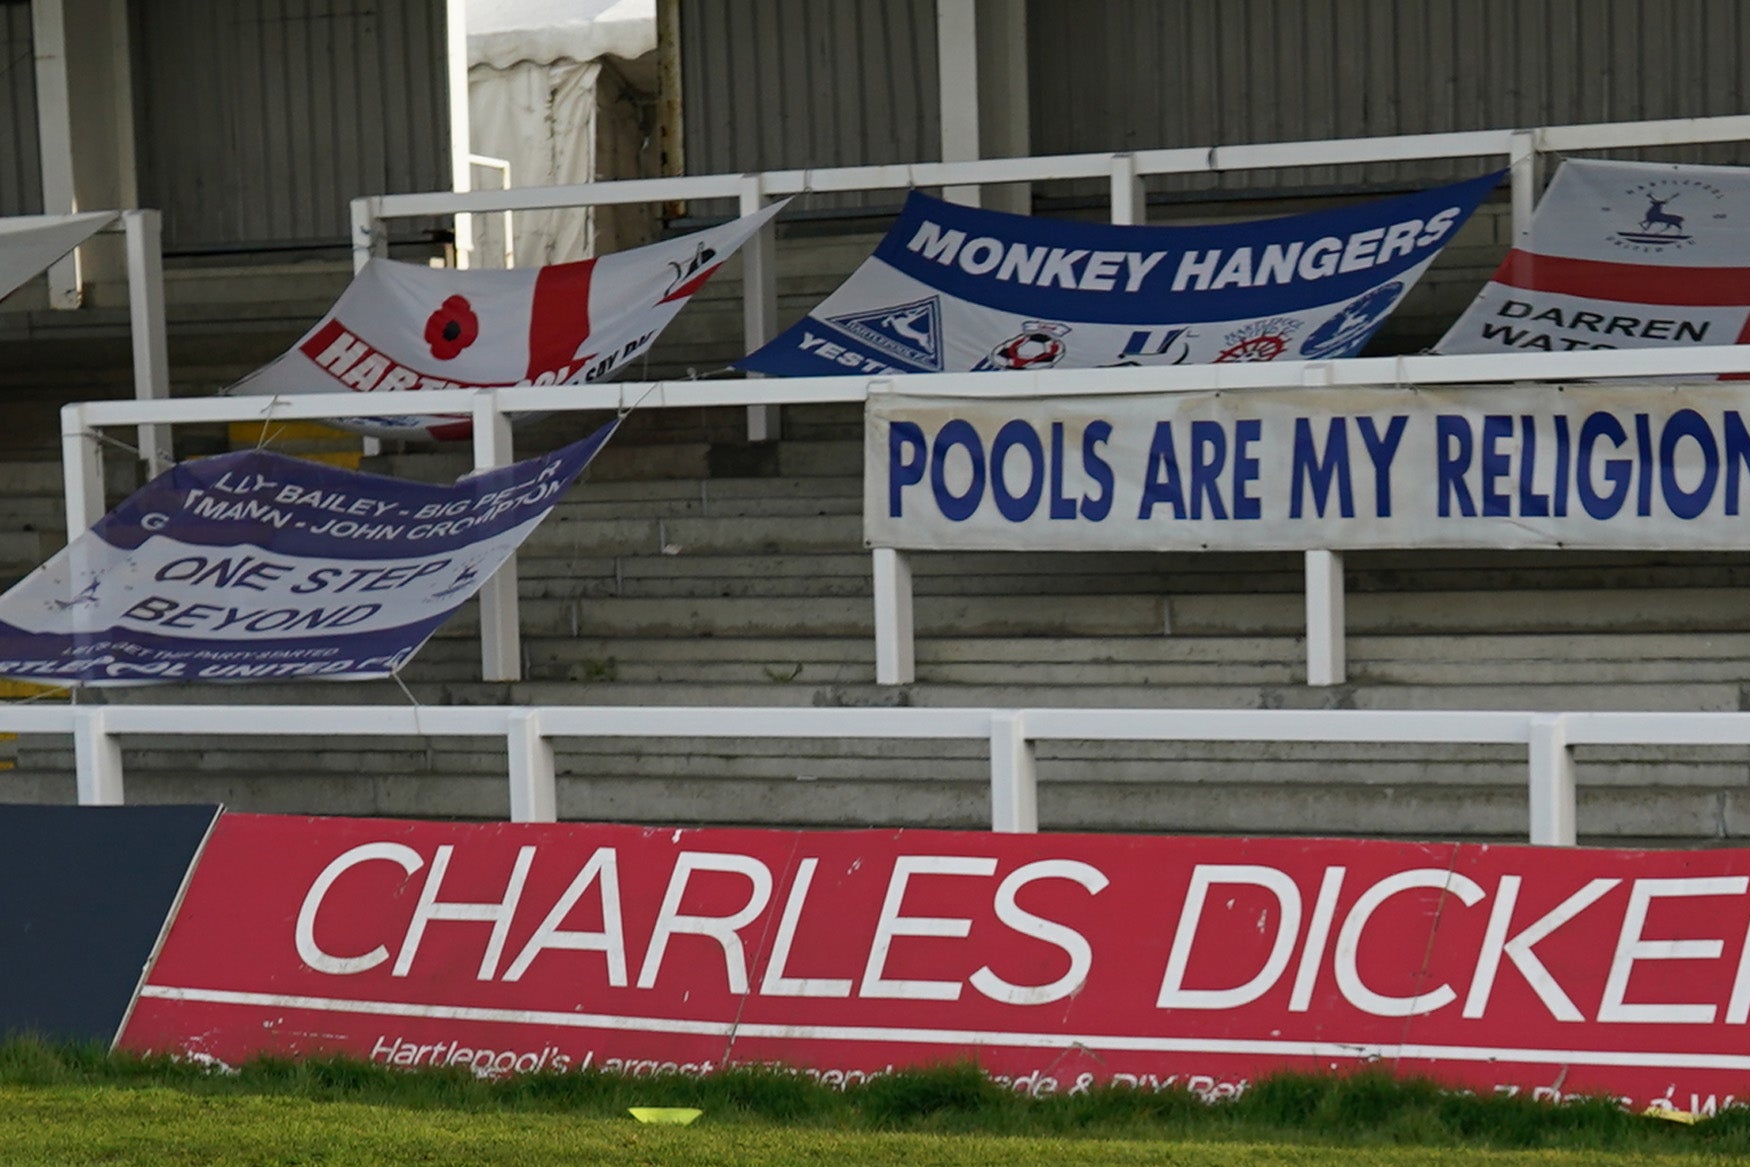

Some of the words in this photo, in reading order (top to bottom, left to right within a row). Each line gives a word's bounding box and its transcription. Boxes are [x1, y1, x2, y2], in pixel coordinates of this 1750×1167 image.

[907, 220, 1164, 293] MONKEY
[1170, 206, 1462, 292] HANGERS
[1497, 300, 1710, 342] DARREN
[797, 332, 907, 374] YEST
[889, 418, 1114, 523] POOLS
[1138, 419, 1262, 521] ARE
[1291, 415, 1409, 520] MY
[276, 484, 399, 517] BAILEY
[415, 499, 471, 519] BIG
[310, 518, 403, 541] JOHN
[154, 556, 294, 591] ONE
[290, 558, 452, 595] STEP
[120, 596, 382, 632] BEYOND
[198, 659, 354, 678] UNITED
[295, 842, 1109, 1006] CHARLES
[370, 1035, 571, 1082] Hartlepool's
[1069, 1072, 1094, 1097] &
